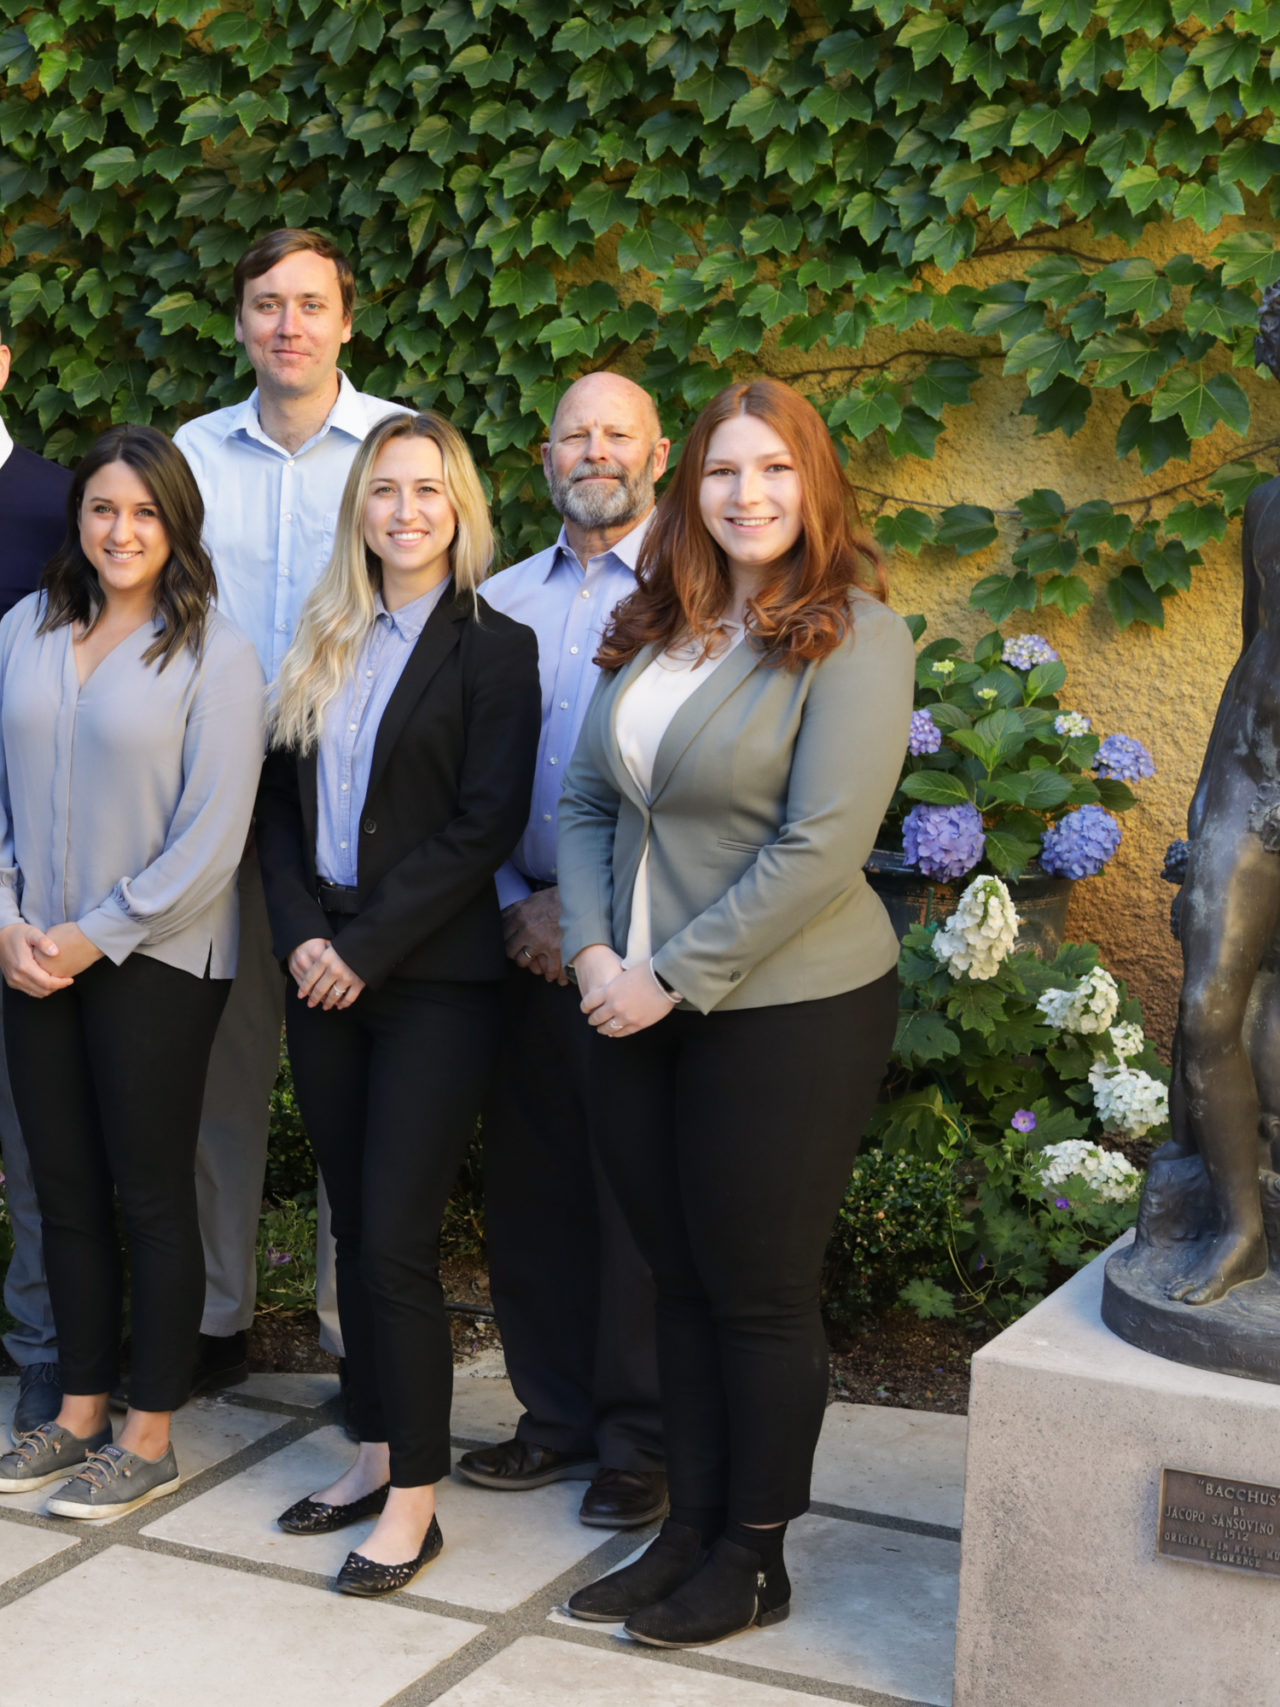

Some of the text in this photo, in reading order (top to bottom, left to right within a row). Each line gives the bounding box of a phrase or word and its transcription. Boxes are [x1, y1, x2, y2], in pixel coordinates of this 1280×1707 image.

[1233, 1506, 1246, 1517] BY
[1165, 1505, 1275, 1536] JACOPO SANSOVINO
[1164, 1531, 1214, 1549] ORIGINAL
[1218, 1541, 1229, 1551] IN
[1224, 1529, 1249, 1542] 1512
[1210, 1551, 1261, 1568] FLORENCE
